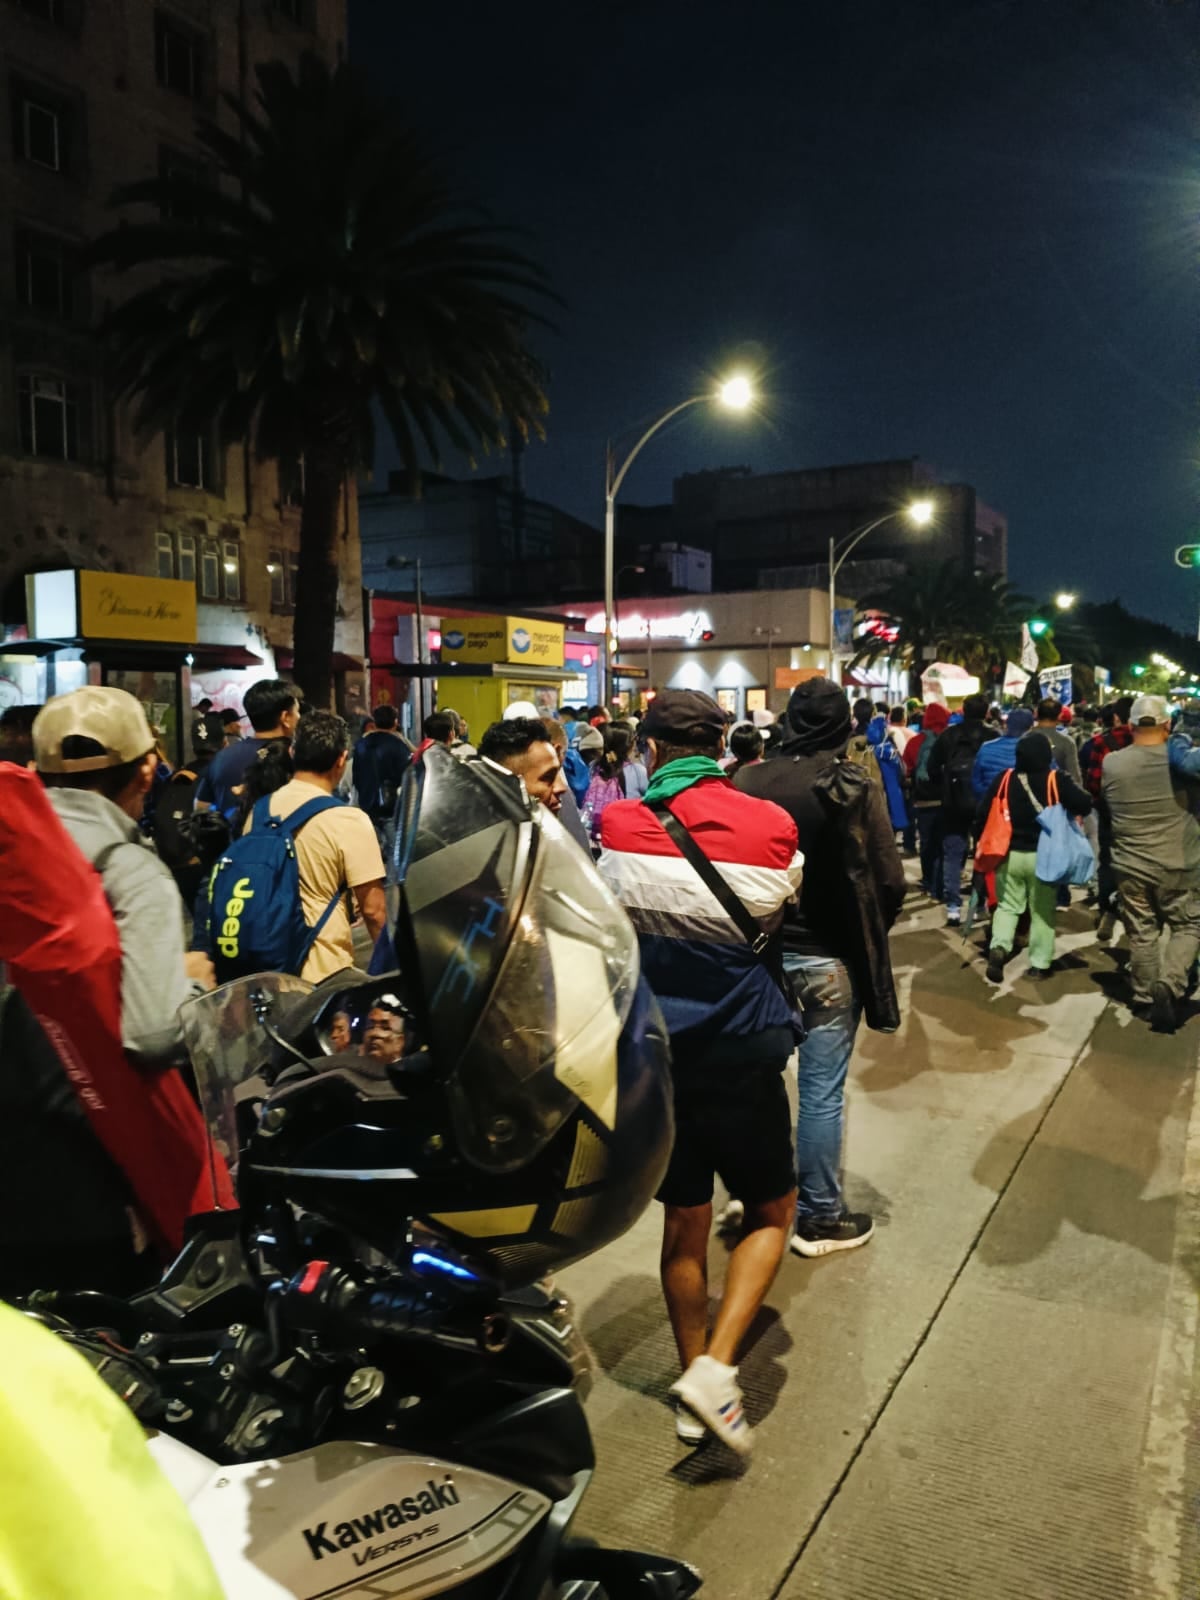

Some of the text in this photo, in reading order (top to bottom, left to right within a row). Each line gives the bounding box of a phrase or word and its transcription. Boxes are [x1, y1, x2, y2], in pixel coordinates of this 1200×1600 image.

[467, 630, 504, 640] mercado
[467, 640, 489, 650] pago
[217, 877, 255, 958] Jeep
[302, 1474, 460, 1560] Kawasaki
[352, 1523, 441, 1567] VERSYS
